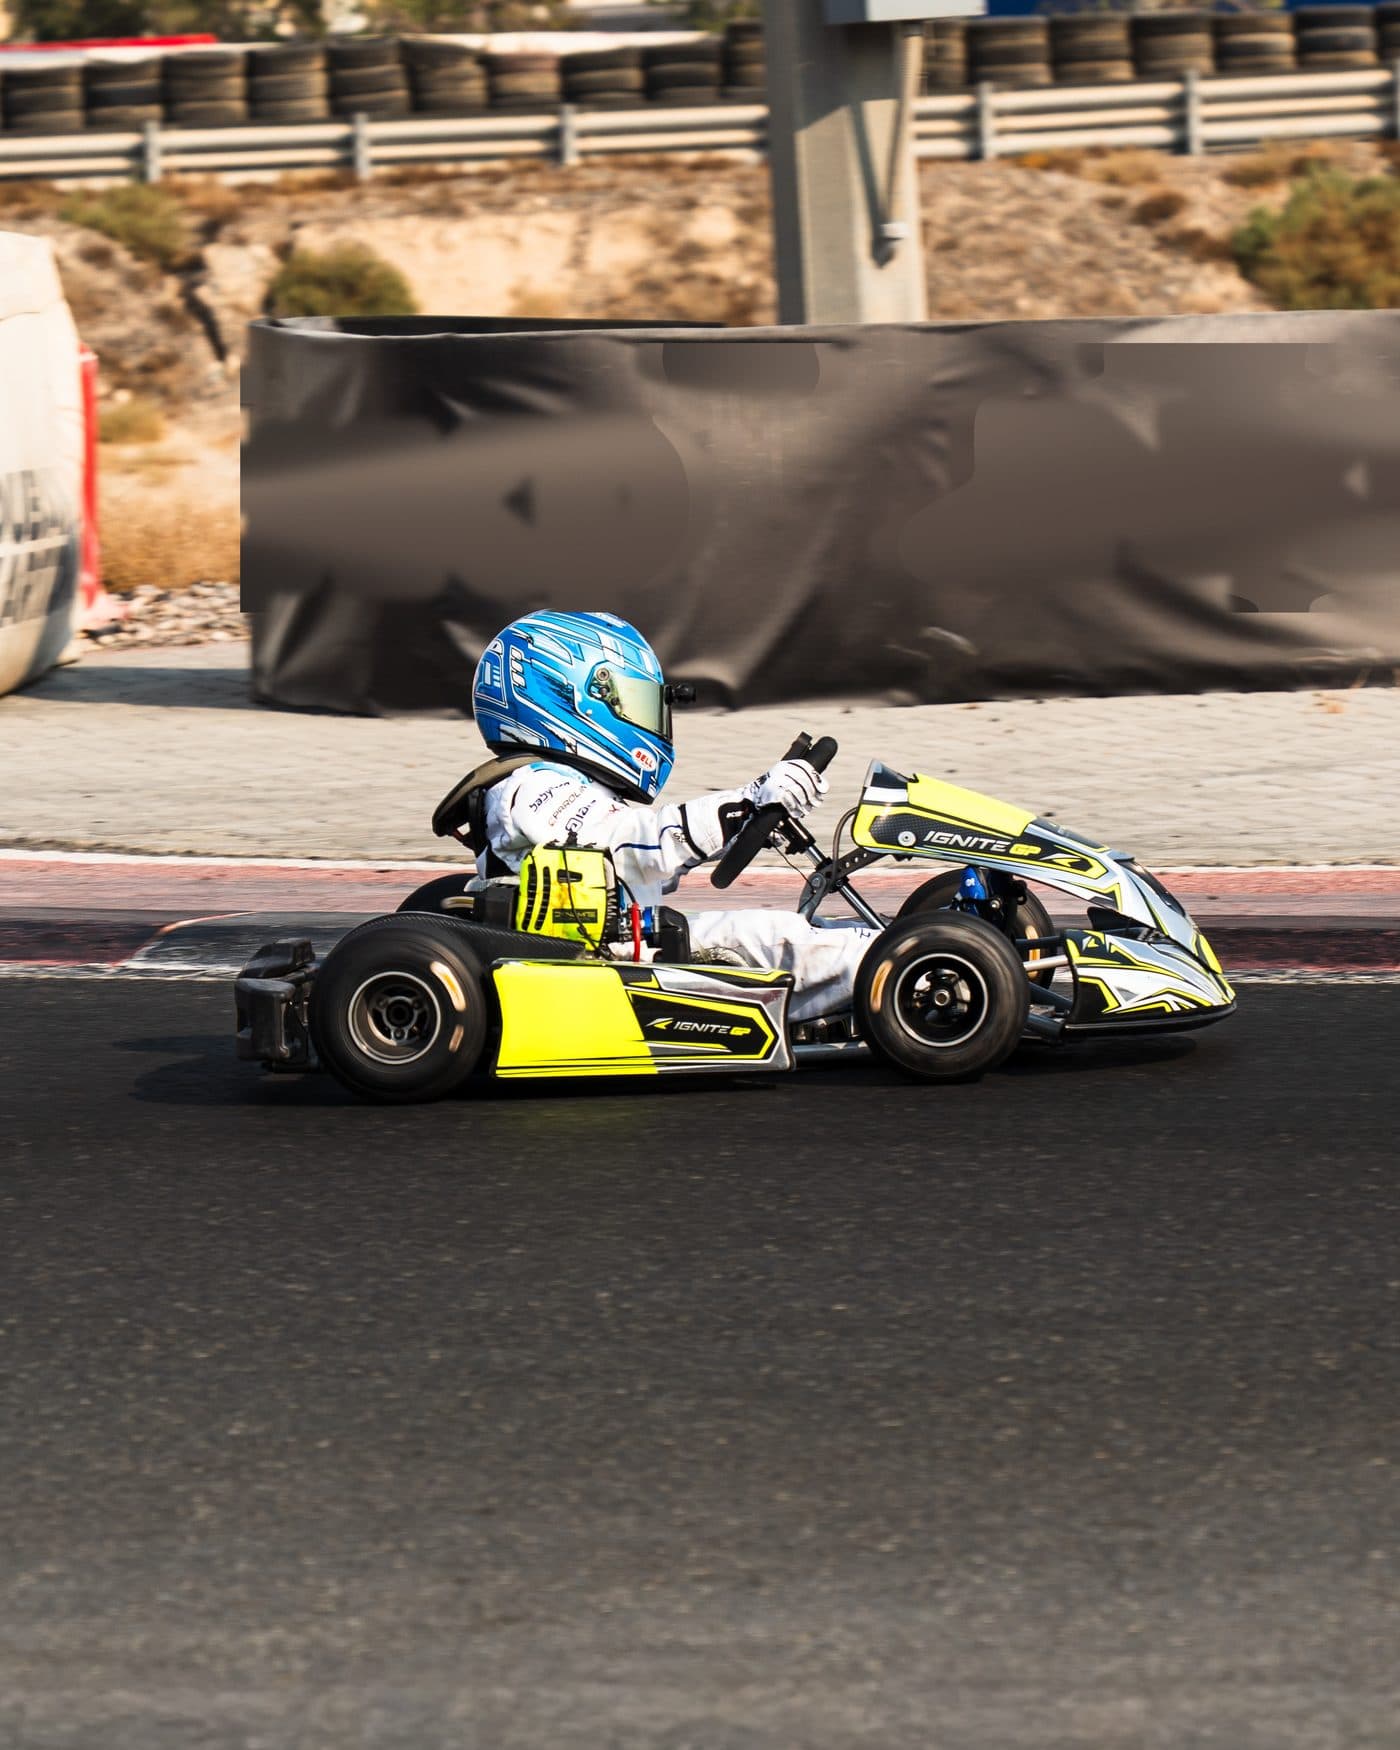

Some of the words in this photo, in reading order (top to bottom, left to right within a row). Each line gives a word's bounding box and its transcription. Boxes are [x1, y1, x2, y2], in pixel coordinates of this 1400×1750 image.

[635, 750, 654, 768] BELL
[922, 830, 1011, 852] IGNITE
[673, 1021, 731, 1034] IGNITE
